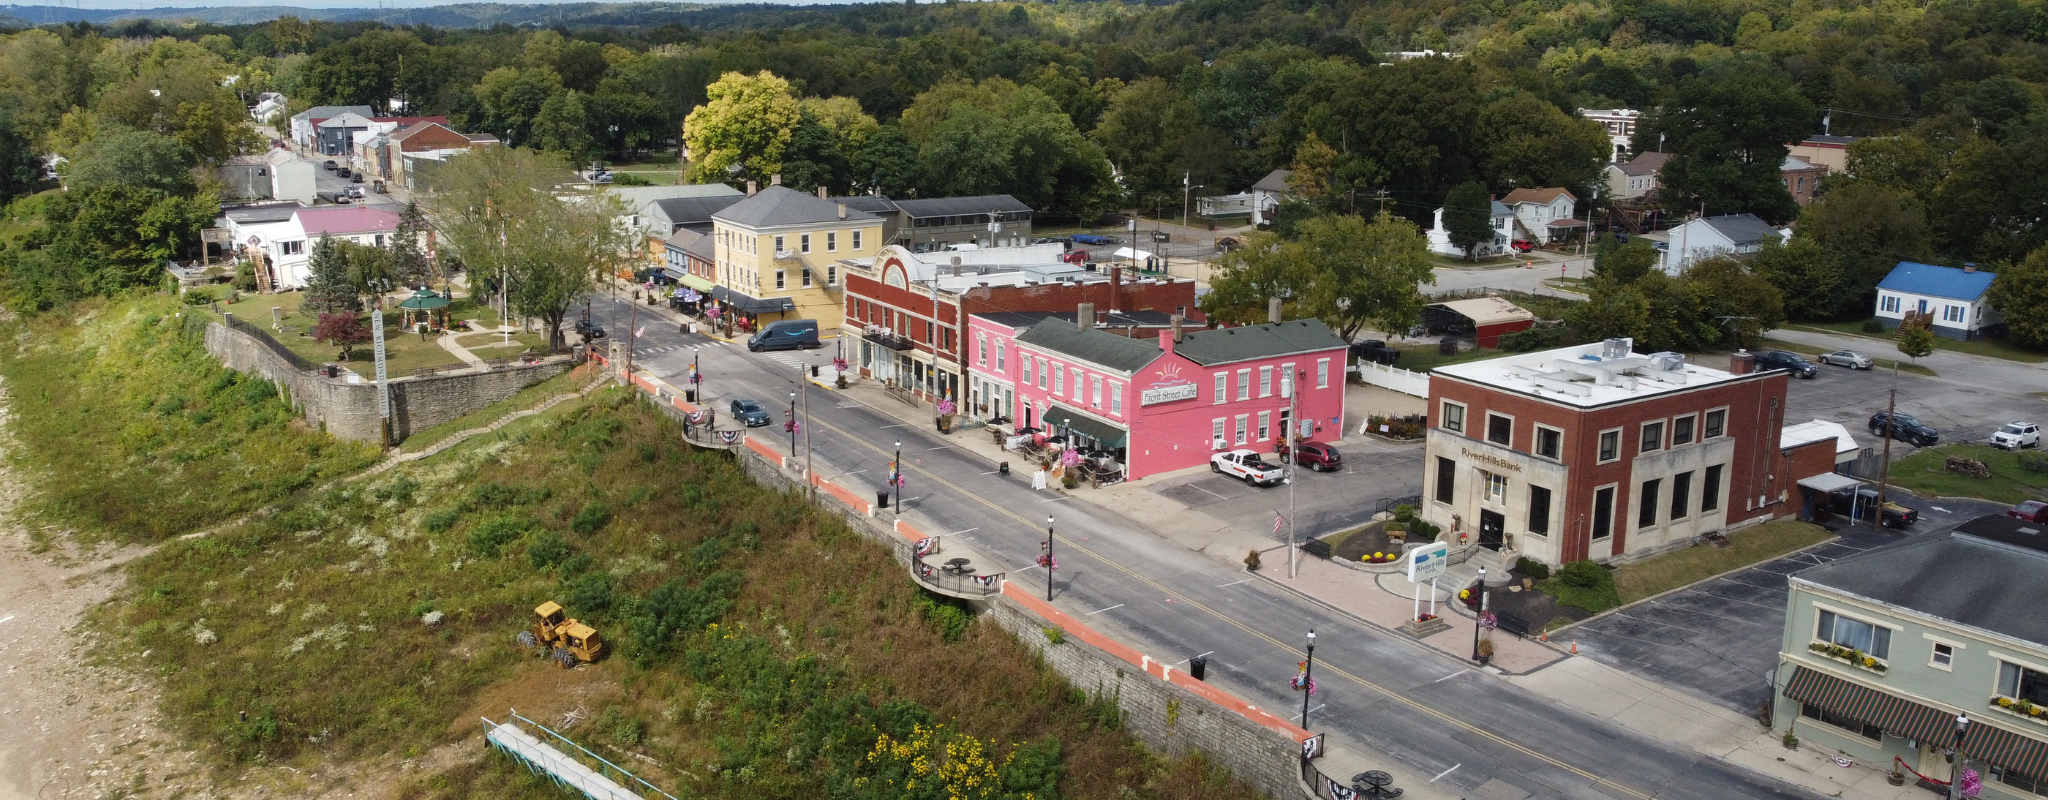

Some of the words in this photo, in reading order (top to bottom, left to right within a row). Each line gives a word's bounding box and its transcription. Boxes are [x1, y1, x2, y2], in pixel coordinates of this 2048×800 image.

[375, 335, 385, 380] RICHMOND
[1144, 391, 1161, 402] Front
[1162, 390, 1181, 400] Street
[1182, 385, 1196, 397] Cafe
[1415, 558, 1445, 573] RiverHills
